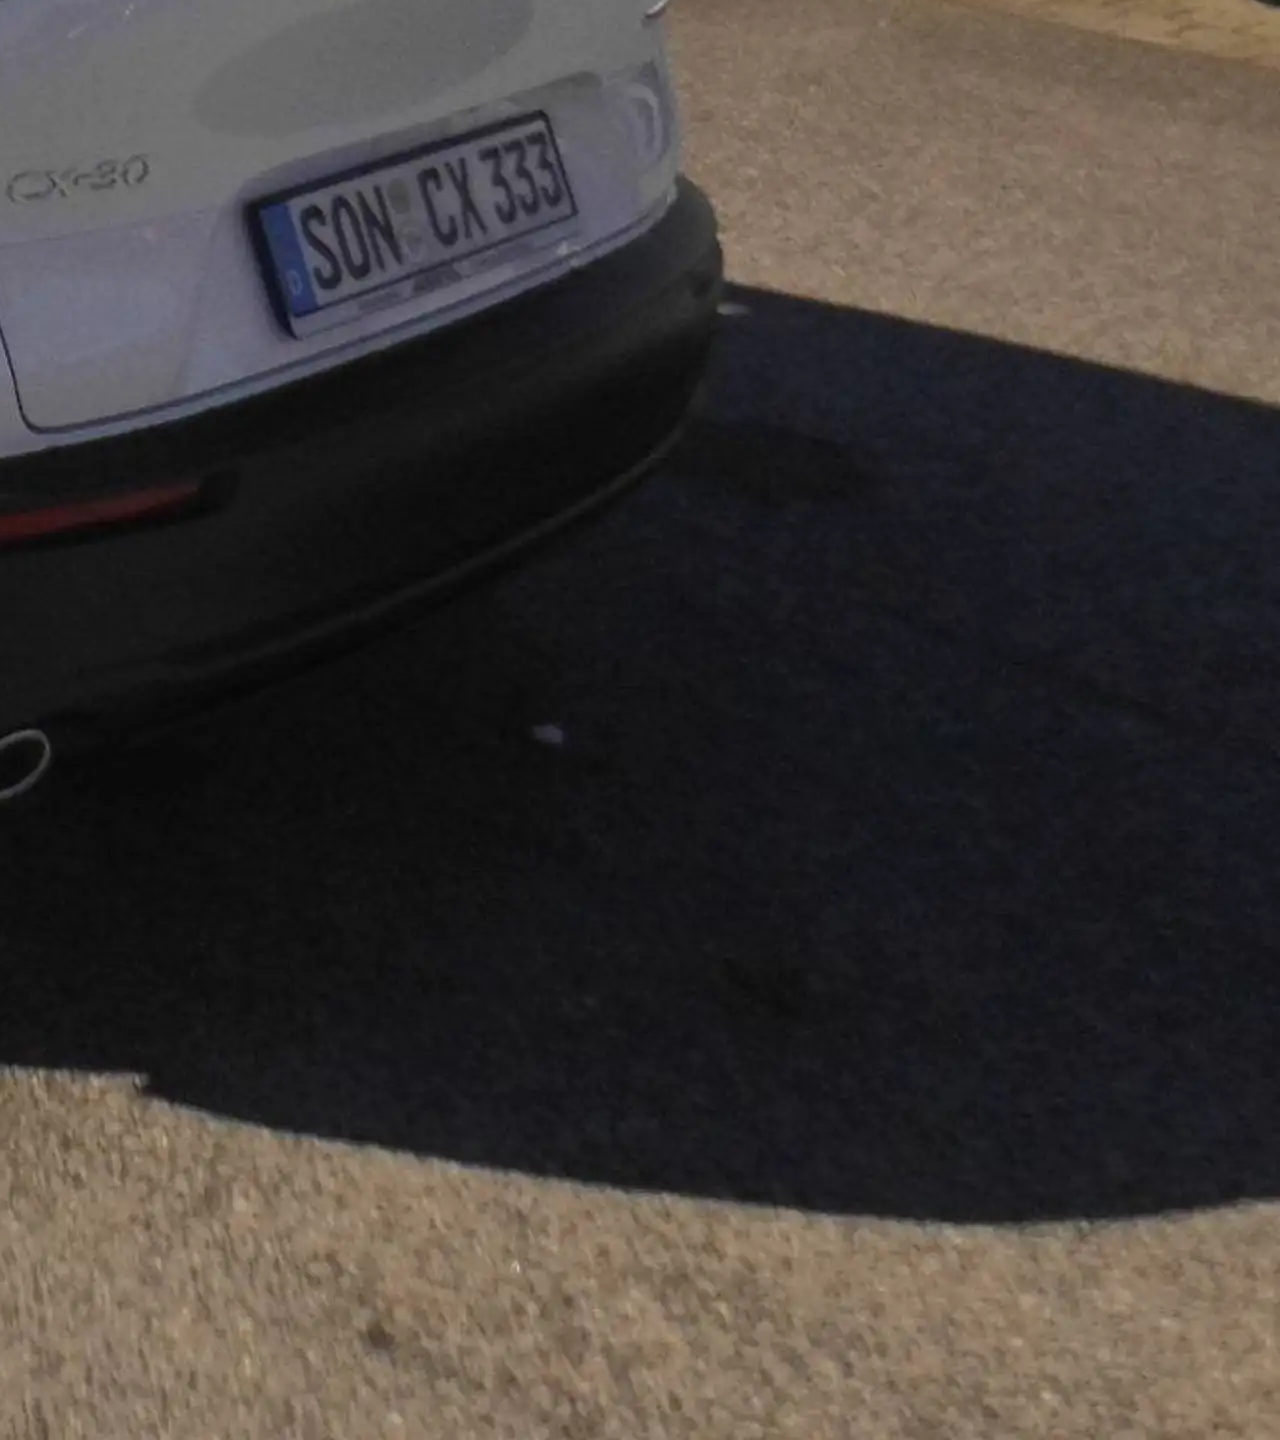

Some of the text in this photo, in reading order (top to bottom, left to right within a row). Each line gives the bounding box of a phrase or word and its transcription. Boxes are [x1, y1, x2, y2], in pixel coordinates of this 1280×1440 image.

[6, 153, 151, 204] CX-30
[299, 130, 565, 291] SON CX 333
